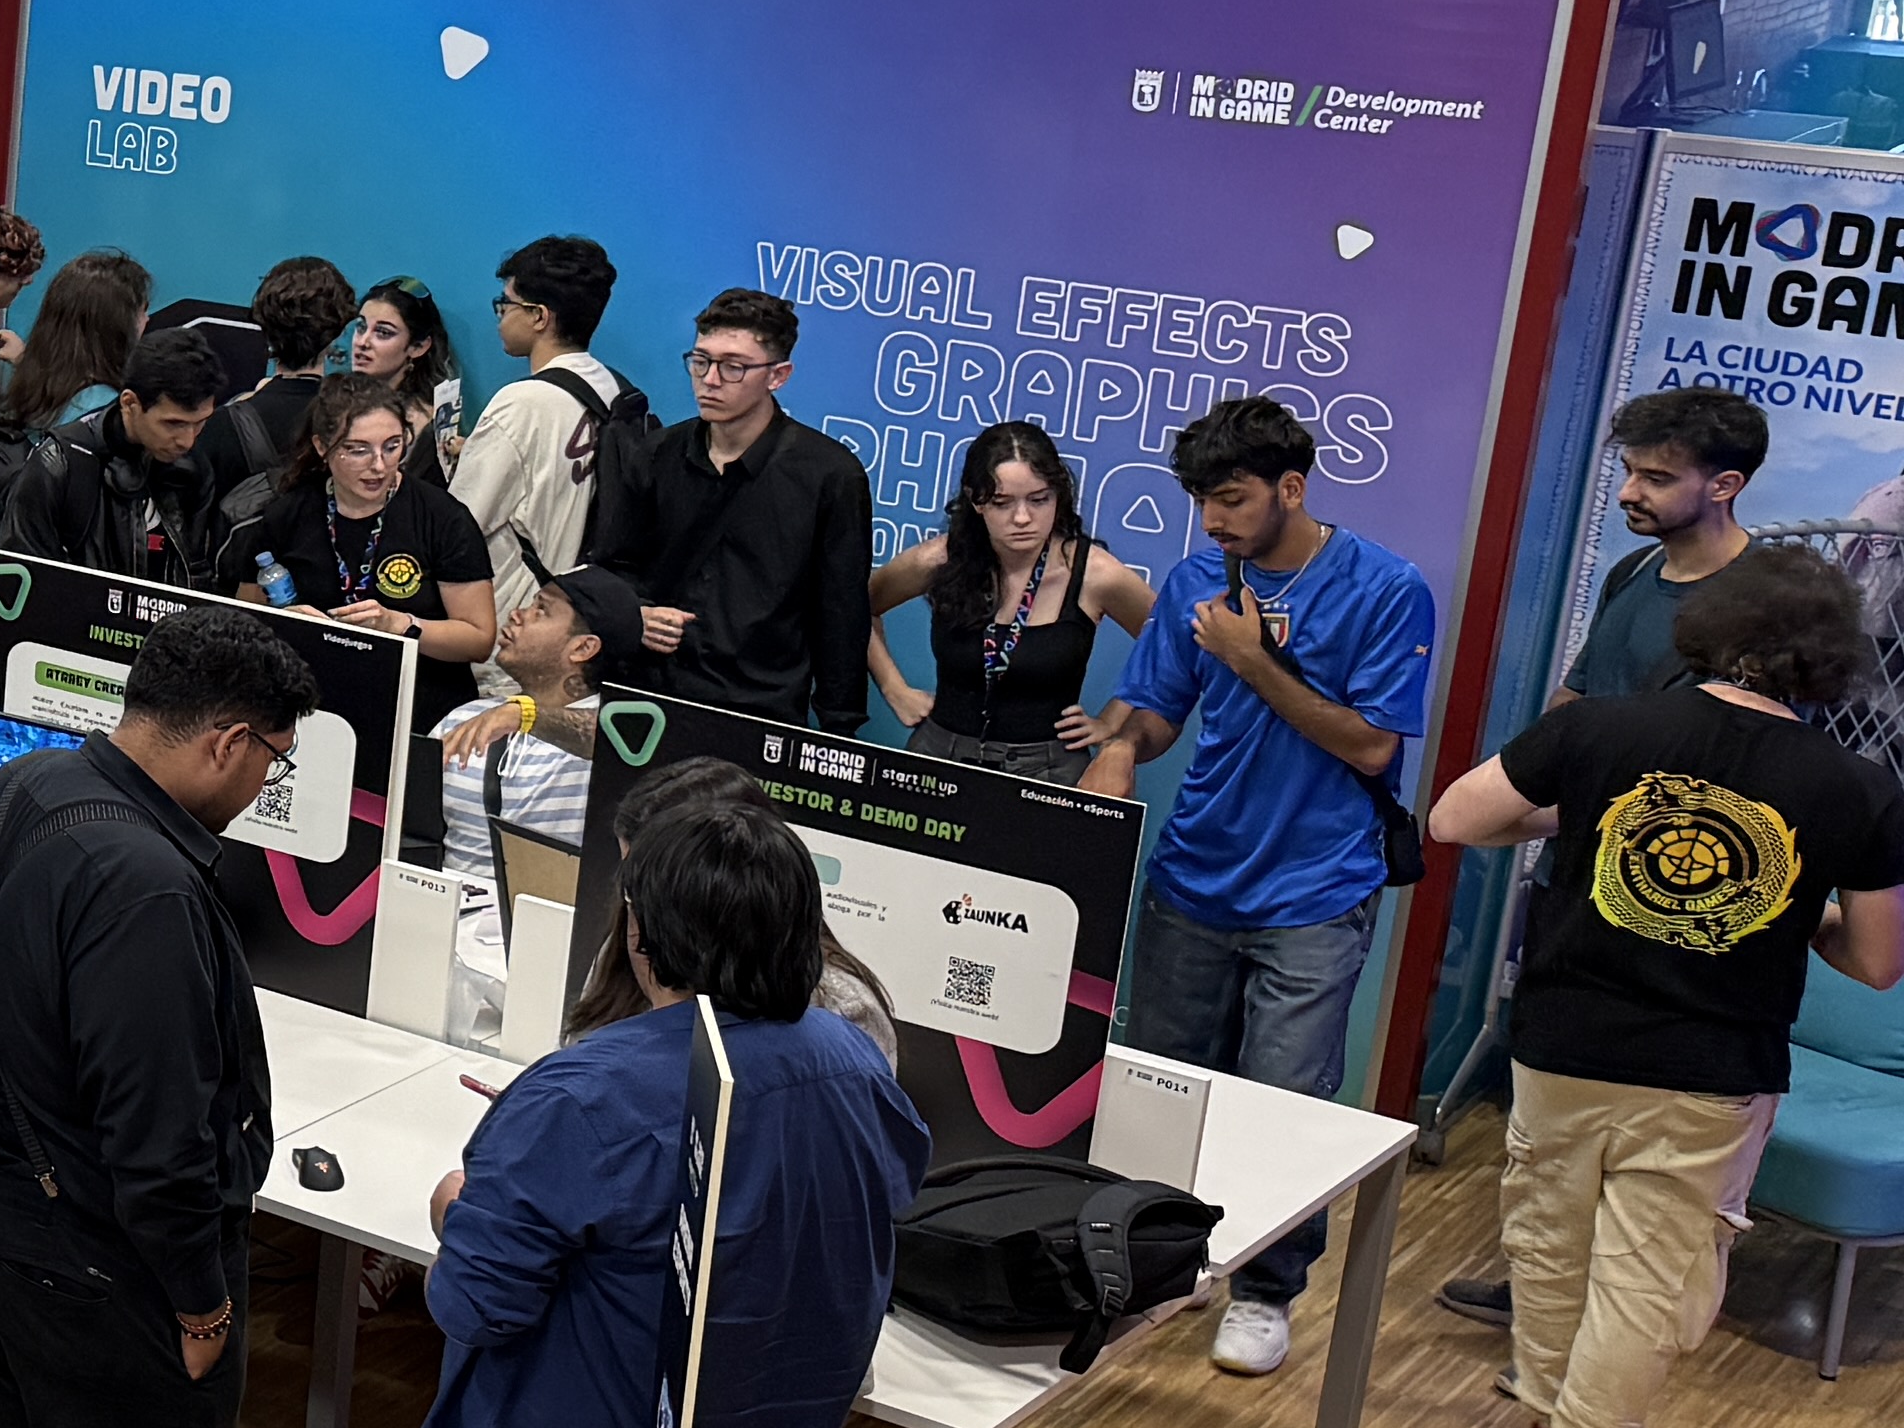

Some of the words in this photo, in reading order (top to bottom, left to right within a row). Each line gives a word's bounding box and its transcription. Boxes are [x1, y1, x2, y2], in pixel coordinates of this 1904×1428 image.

[93, 65, 232, 124] VIDEO
[1325, 86, 1485, 120] Development
[1190, 97, 1216, 118] IN
[1220, 101, 1292, 125] GAME
[1314, 108, 1393, 135] Center
[86, 119, 178, 174] LAB
[1671, 259, 1753, 320] IN
[757, 242, 992, 329] VISUAL
[1016, 275, 1352, 377] EFFECTS
[1664, 337, 1708, 367] LA
[1718, 344, 1863, 384] CIUDAD
[1657, 367, 1682, 390] A
[874, 330, 1392, 484] GRAPHS
[799, 756, 816, 772] IN
[818, 760, 865, 783] GAME
[882, 767, 919, 786] start
[921, 774, 937, 790] IN
[938, 779, 958, 796] up
[1020, 788, 1074, 809] Educación
[839, 799, 854, 816] &
[861, 803, 919, 832] DEMO
[924, 818, 967, 842] DAY
[963, 907, 1029, 934] ZAUNKA
[1156, 1077, 1189, 1095] P014
